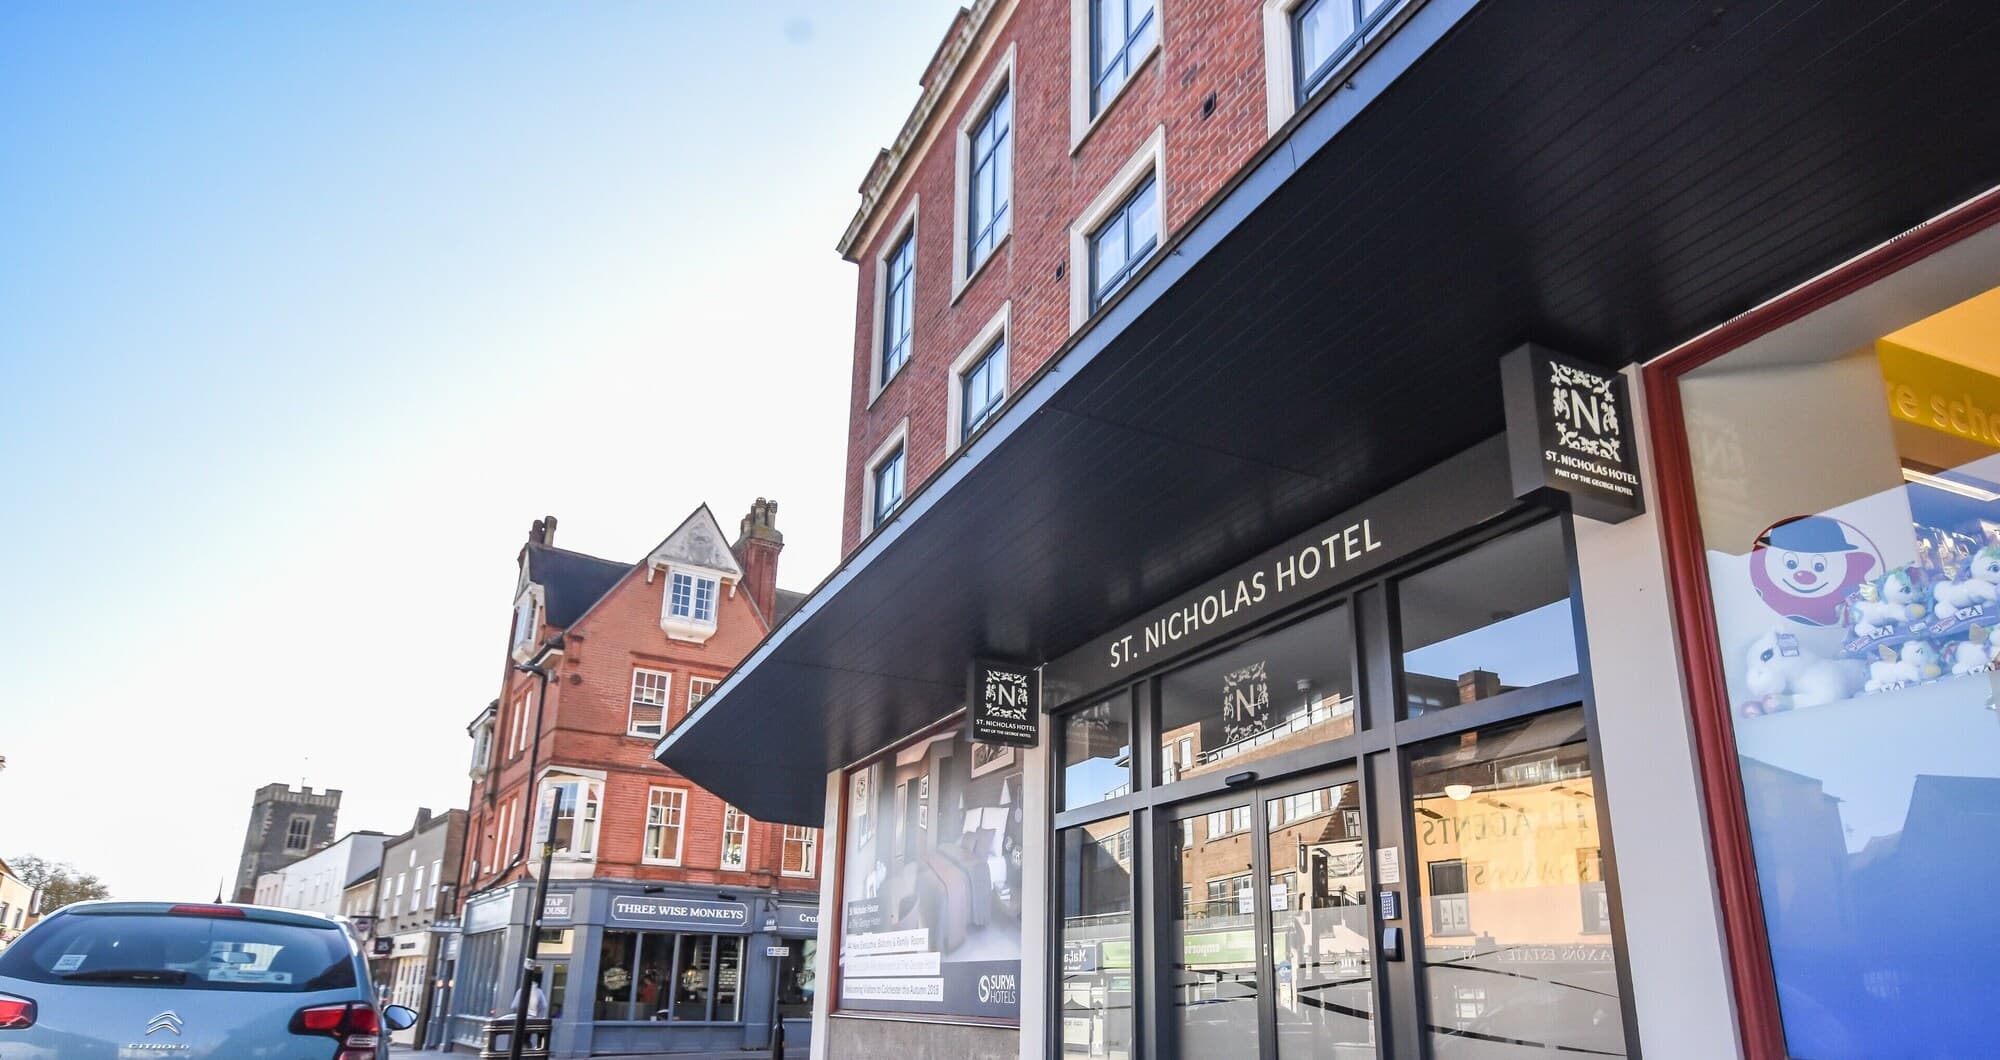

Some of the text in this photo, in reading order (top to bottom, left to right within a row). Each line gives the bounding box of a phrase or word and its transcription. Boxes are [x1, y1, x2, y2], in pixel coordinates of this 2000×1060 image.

[1570, 389, 1601, 435] N
[1545, 450, 1639, 485] ST. NICHOLAS HOTEL
[1554, 468, 1634, 496] PART OF THE GEORGE HOTEL
[1110, 519, 1382, 668] ST. NICHOLAS HOTEL
[998, 683, 1016, 707] N
[976, 718, 1036, 732] ST. NICHOLAS HOTEL
[546, 898, 564, 906] TAP
[543, 906, 568, 915] OUSE
[617, 903, 744, 919] THREE WISE MONKEYS
[990, 974, 1016, 990] SURYA
[990, 990, 1016, 1004] HOTELS
